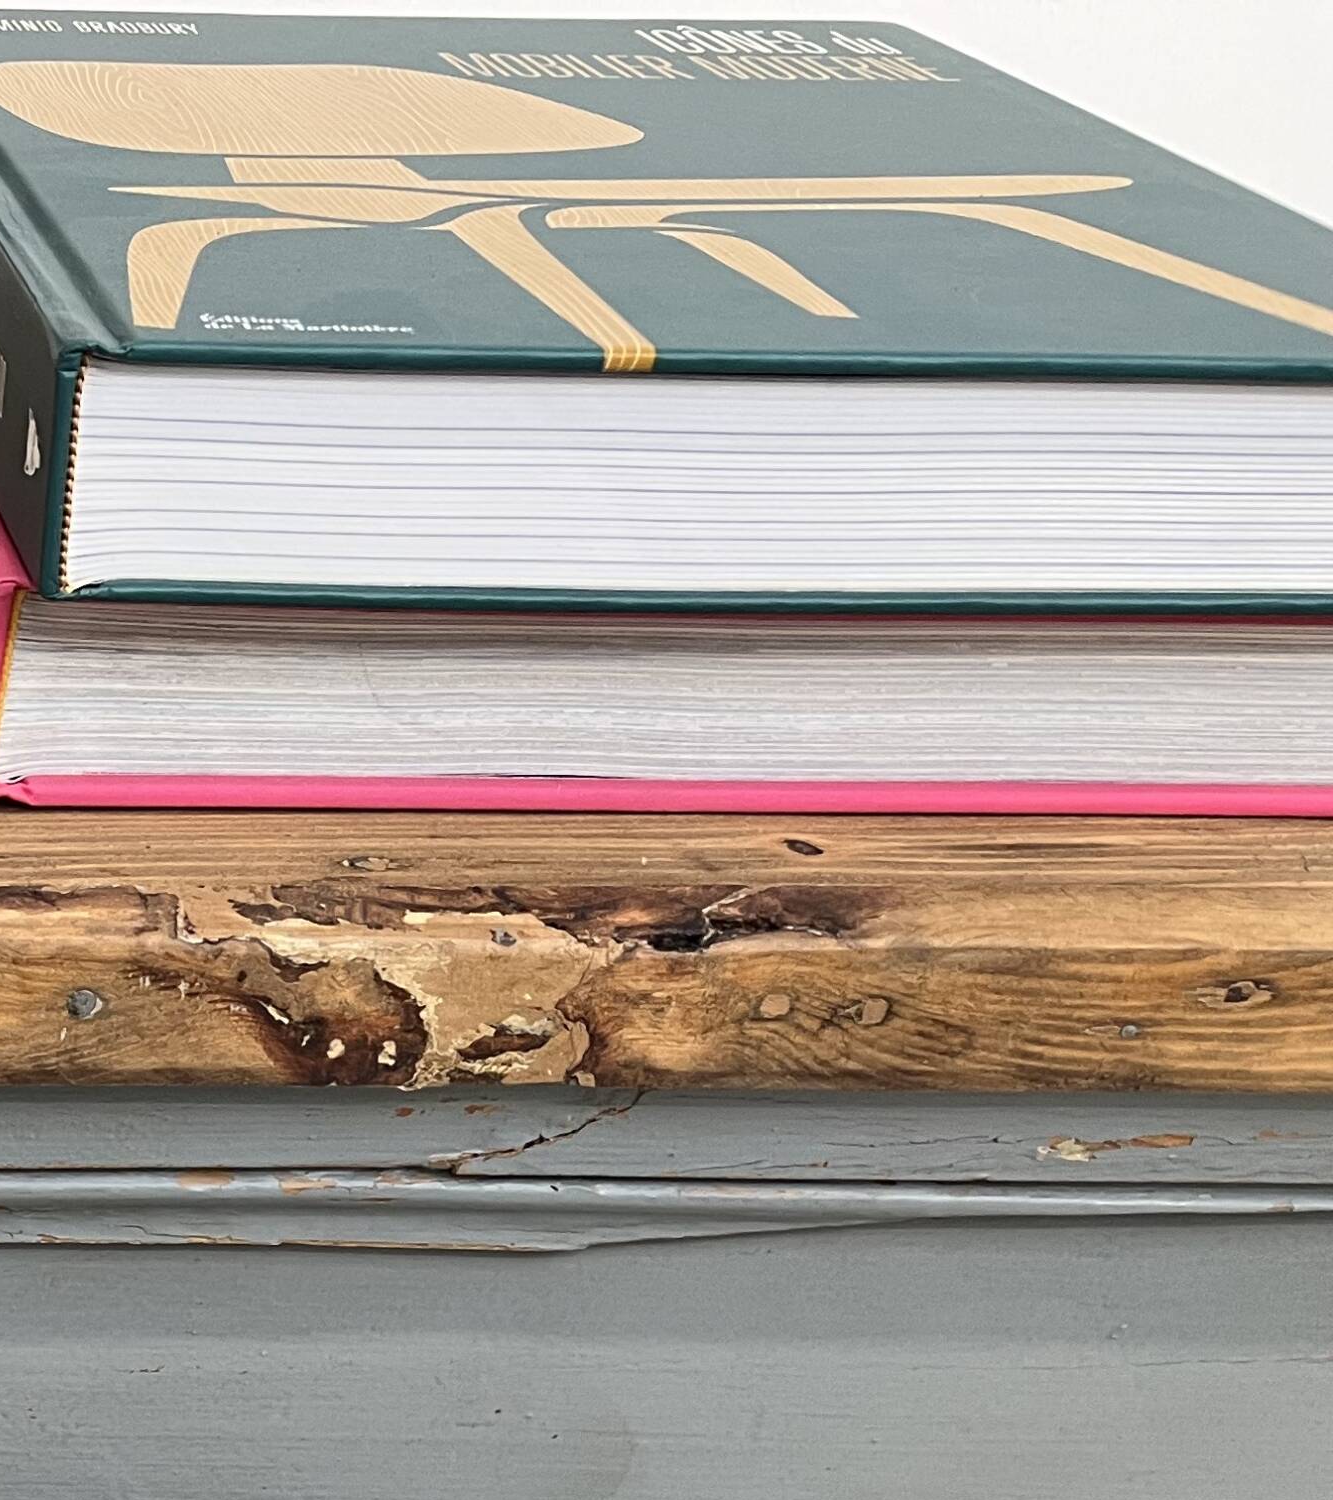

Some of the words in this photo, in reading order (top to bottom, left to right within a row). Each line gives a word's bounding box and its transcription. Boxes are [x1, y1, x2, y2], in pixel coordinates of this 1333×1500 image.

[72, 20, 199, 36] BRADBURY
[634, 24, 829, 56] ICÔNES
[830, 29, 904, 55] du
[437, 51, 697, 80] MOBILIER
[691, 53, 961, 82] MODERNE
